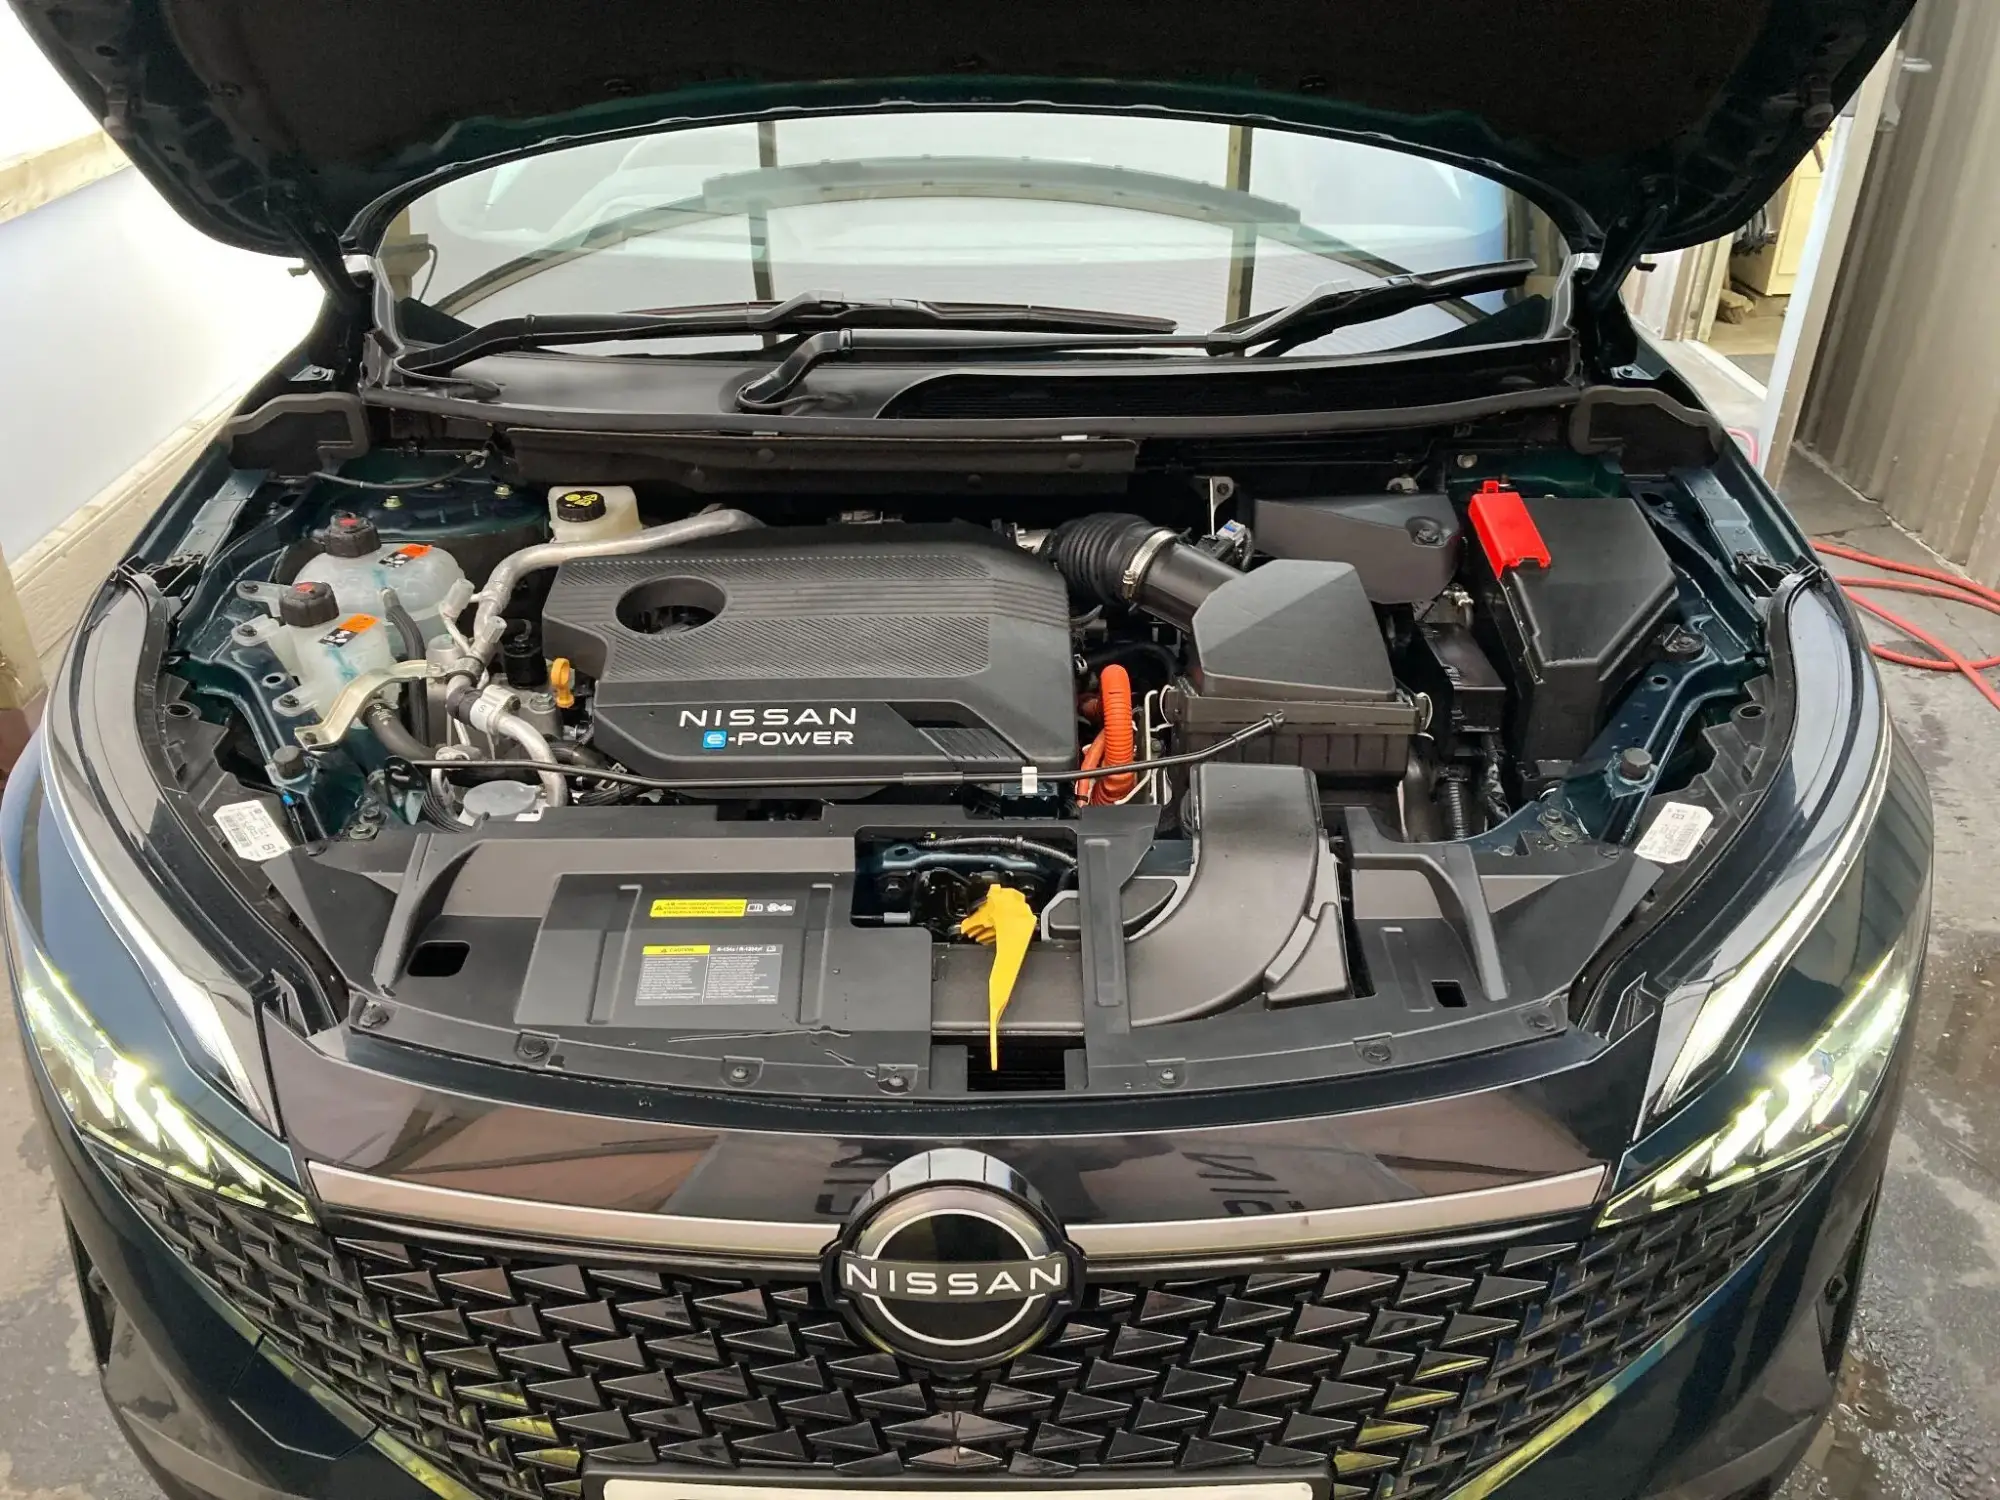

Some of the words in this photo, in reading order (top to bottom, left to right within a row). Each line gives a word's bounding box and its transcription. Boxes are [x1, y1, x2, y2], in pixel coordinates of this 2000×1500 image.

[679, 707, 857, 727] NISSAN
[704, 730, 854, 747] e-POWER
[846, 1263, 1061, 1296] NISSAN
